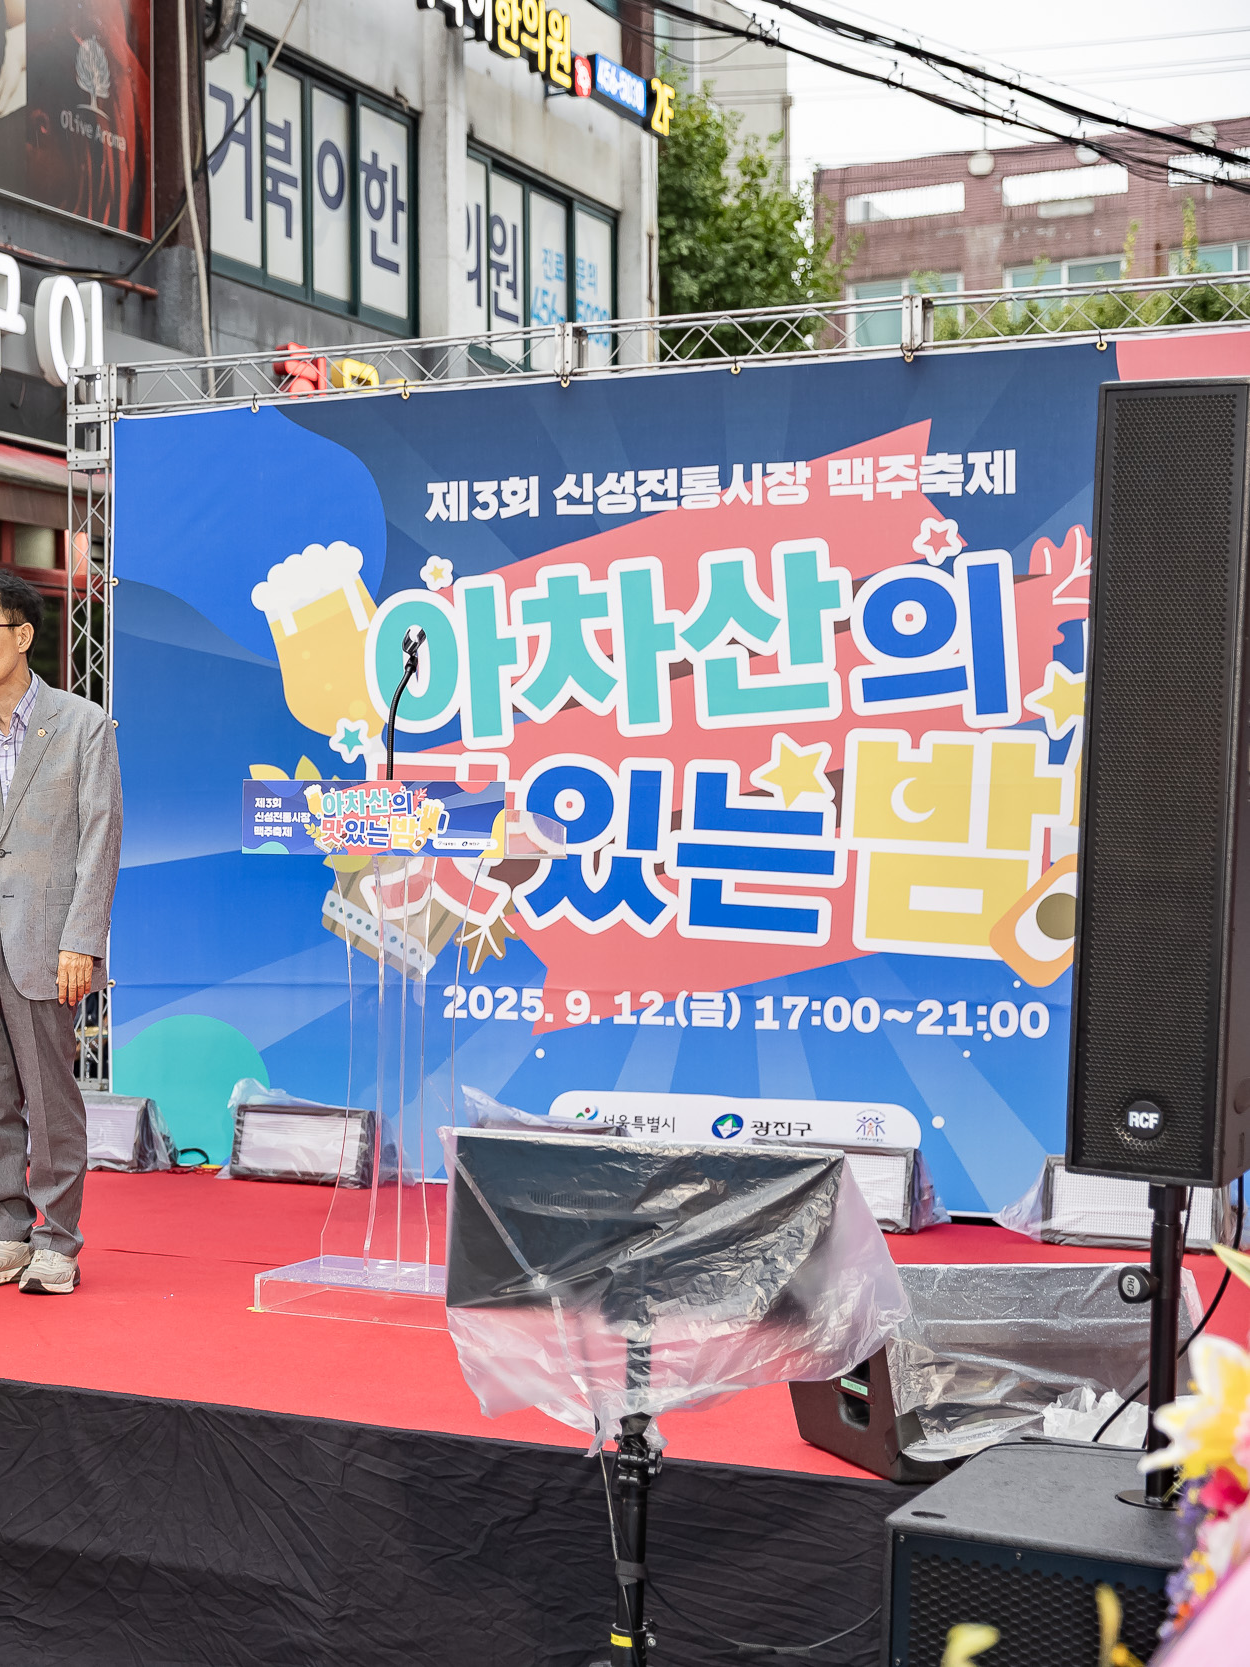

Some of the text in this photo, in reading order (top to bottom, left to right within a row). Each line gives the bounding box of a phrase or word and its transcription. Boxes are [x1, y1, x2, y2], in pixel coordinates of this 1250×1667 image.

[650, 77, 676, 137] 2F
[425, 448, 1017, 522] 제3회 신성전통시장 맥주축제
[375, 550, 1010, 739] 아차산의
[254, 789, 413, 816] 제3회 아차산의
[254, 811, 311, 823] 신성전통시장
[253, 825, 293, 838] 맥주축제
[443, 984, 554, 1023] 2025.
[564, 991, 601, 1025] 9.
[754, 999, 1051, 1039] 17:00~21:00
[751, 1119, 813, 1138] 광진구
[1127, 1111, 1159, 1130] RCF
